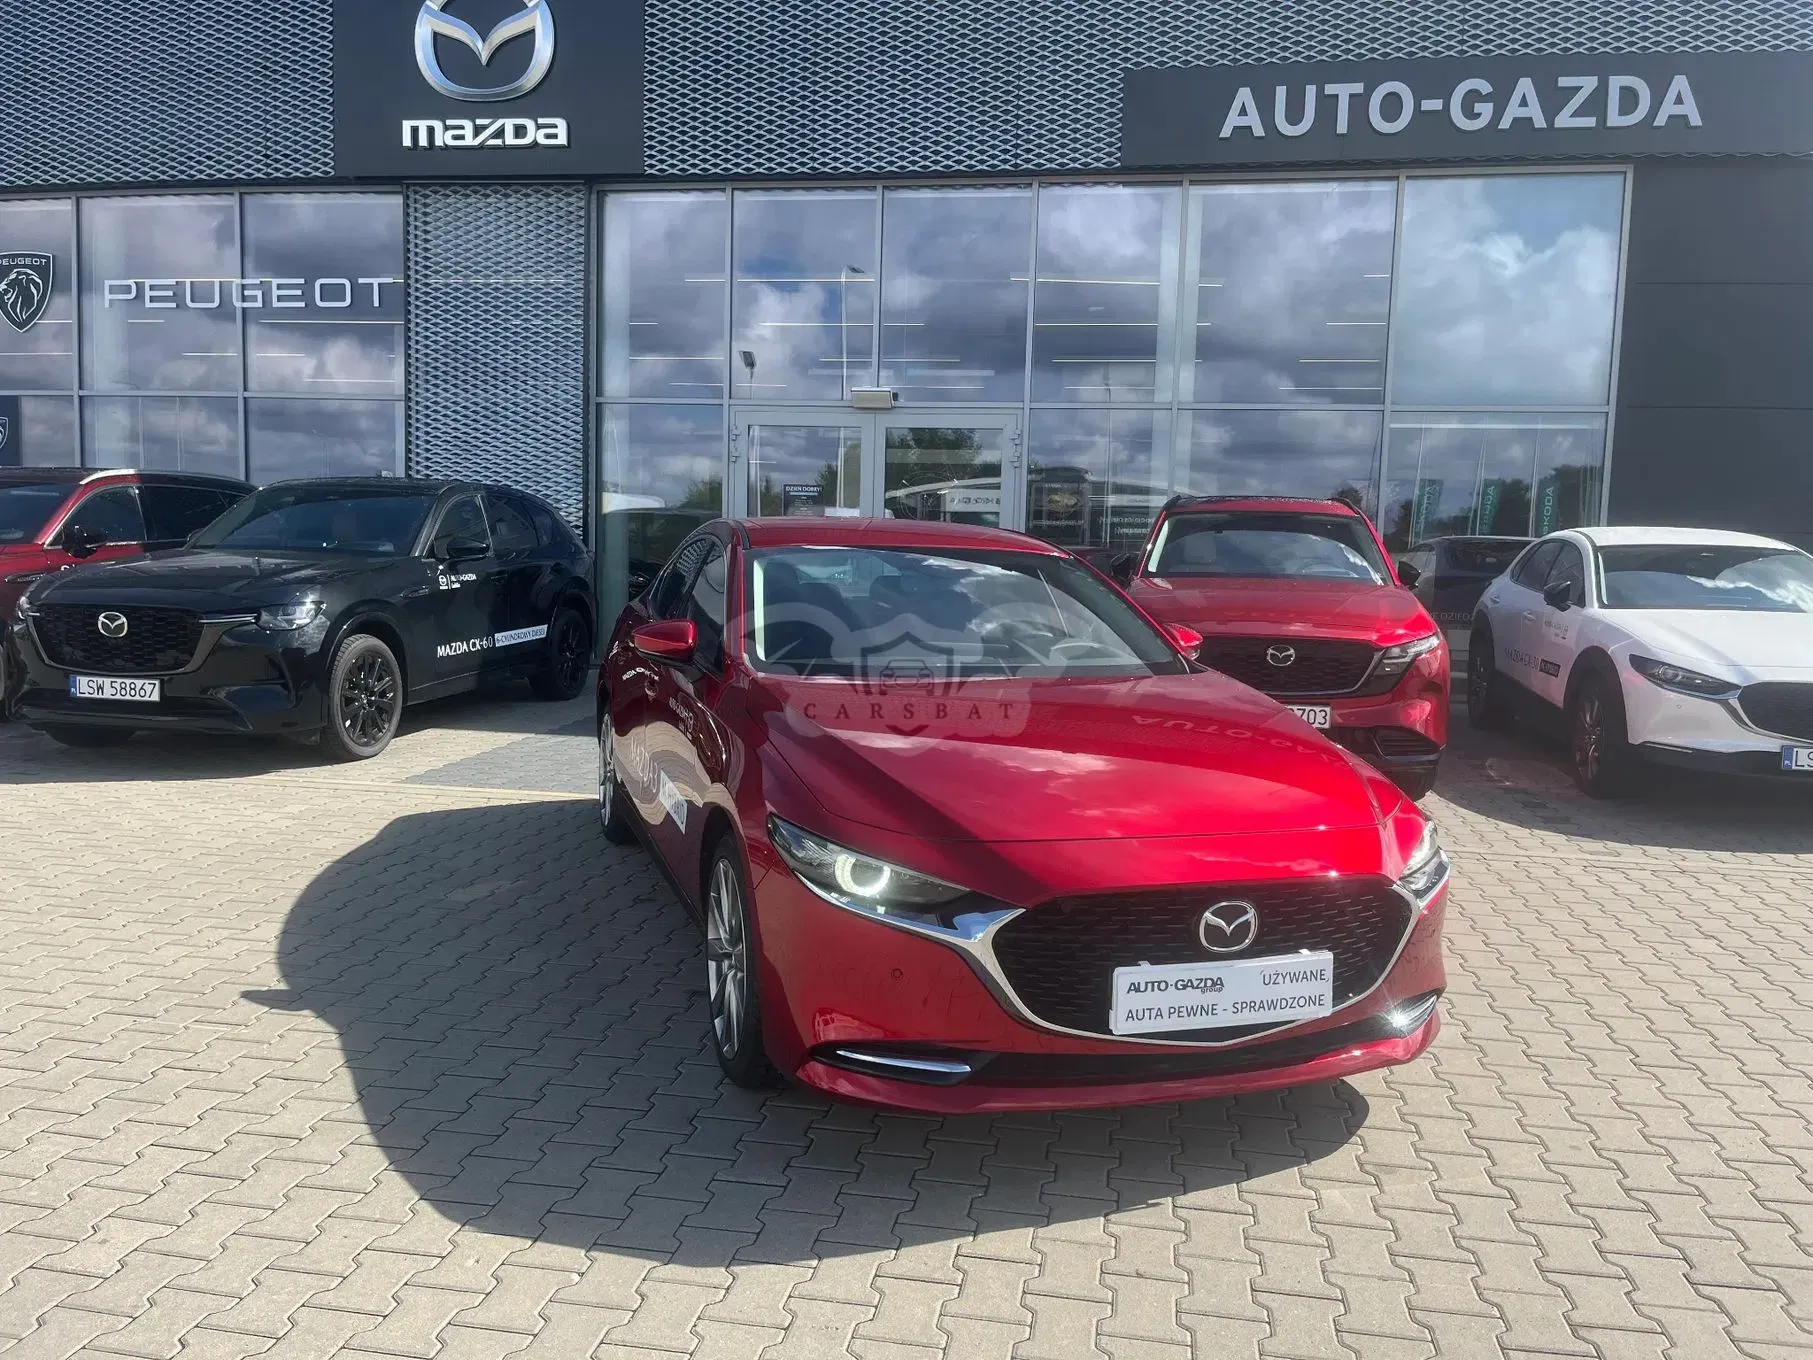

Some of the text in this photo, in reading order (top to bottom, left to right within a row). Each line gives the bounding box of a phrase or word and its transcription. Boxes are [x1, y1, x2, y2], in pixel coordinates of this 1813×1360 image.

[1218, 74, 1703, 139] AUTO-GAZDA
[104, 277, 394, 309] PEUGEOT
[437, 641, 468, 657] MAZDA
[469, 636, 493, 652] CX-60
[78, 679, 156, 699] LSW 58867
[1289, 708, 1328, 726] 703
[1262, 969, 1327, 986] UŻYWANE
[1200, 986, 1224, 994] group
[1125, 1007, 1163, 1022] AUTA
[1168, 1004, 1218, 1018] PEWNE
[1232, 994, 1325, 1014] SPRAWDZONE
